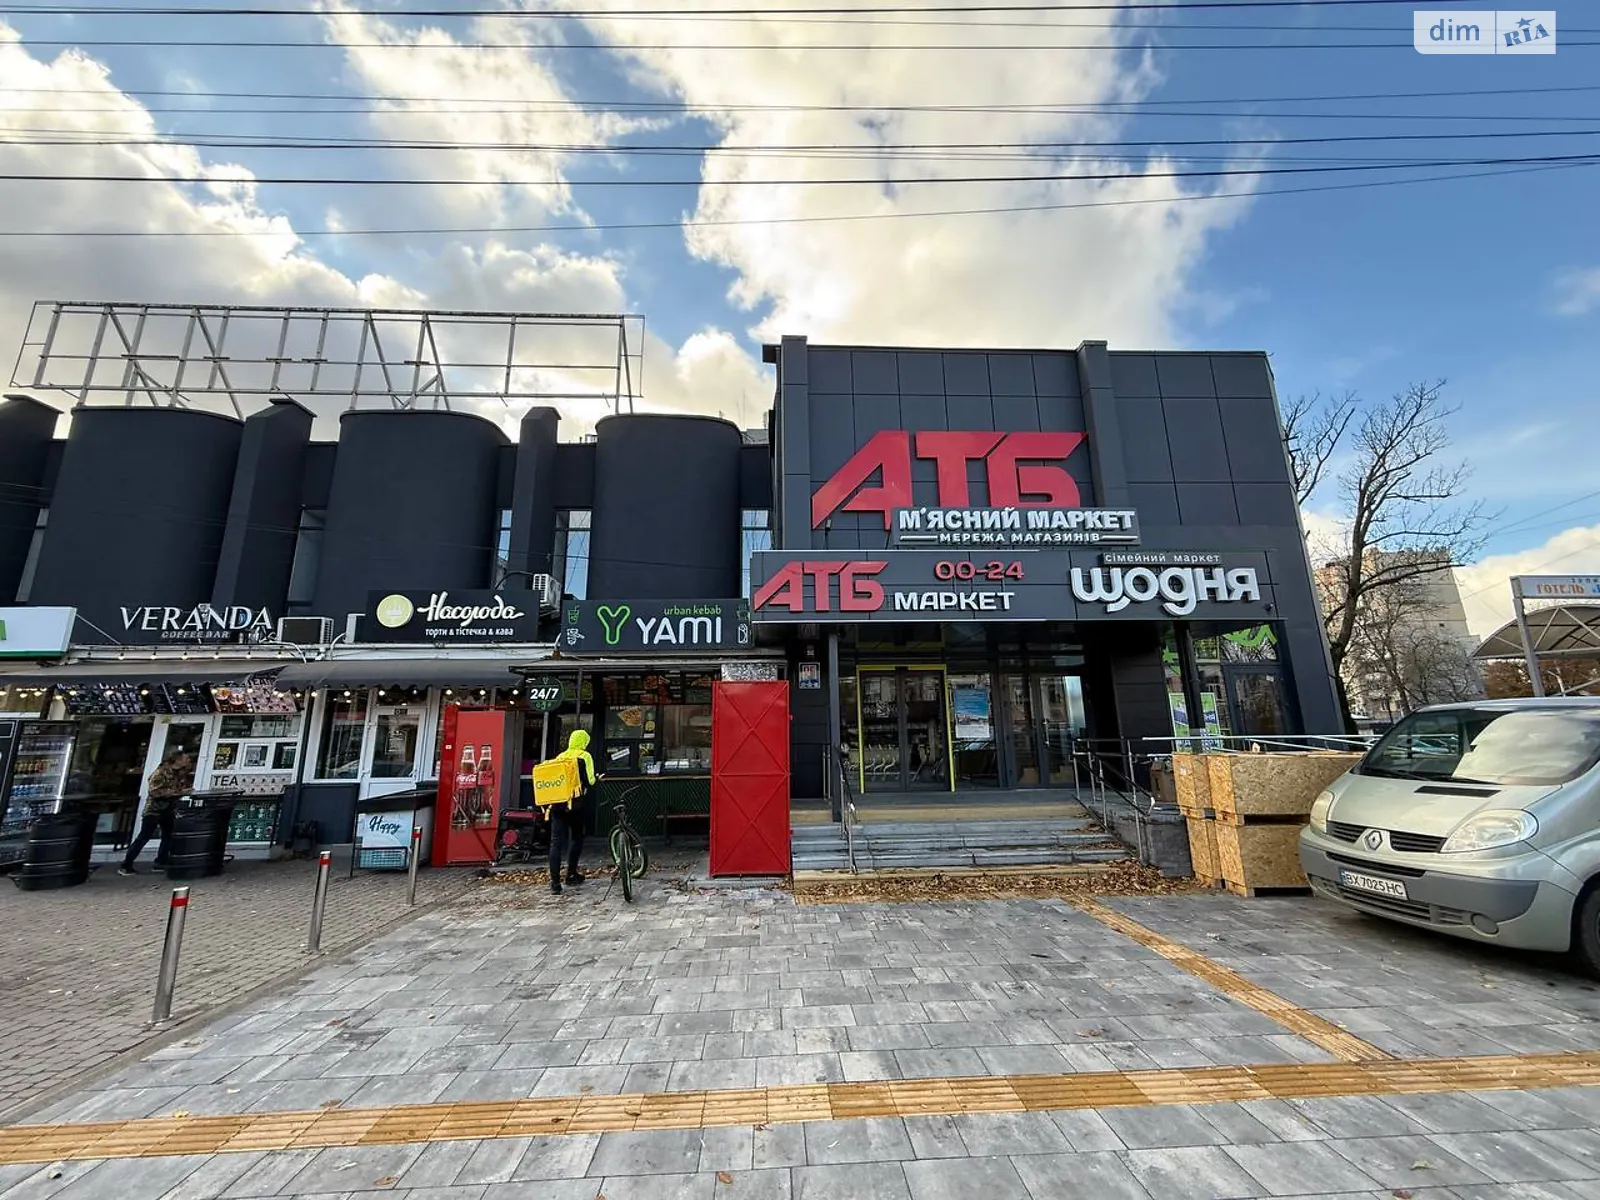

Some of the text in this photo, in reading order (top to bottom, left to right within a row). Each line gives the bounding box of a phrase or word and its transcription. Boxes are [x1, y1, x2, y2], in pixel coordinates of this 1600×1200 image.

[811, 430, 1088, 531] АТБ
[899, 507, 1135, 530] М'ЯСНИЙ МАРКЕТ
[939, 533, 1100, 543] МЕРЕЖА МАГАЗИНІВ
[1104, 553, 1221, 564] сімейний маркет
[934, 561, 1025, 581] 00-24
[753, 560, 889, 612] АТБ
[1070, 567, 1261, 616] щодня
[1536, 584, 1585, 594] ГОТЕЛЬ
[417, 591, 525, 627] Насолода
[664, 604, 722, 616] urban kebab
[894, 591, 1015, 610] МАРКЕТ
[120, 606, 272, 630] VERANDA
[161, 630, 231, 639] COFFEE BAR
[425, 627, 514, 638] торти & тістечка & кава
[636, 617, 722, 645] YAMI
[530, 688, 559, 700] 24/7
[213, 776, 239, 786] TEA
[535, 778, 561, 790] Glovo
[369, 816, 401, 835] Happy
